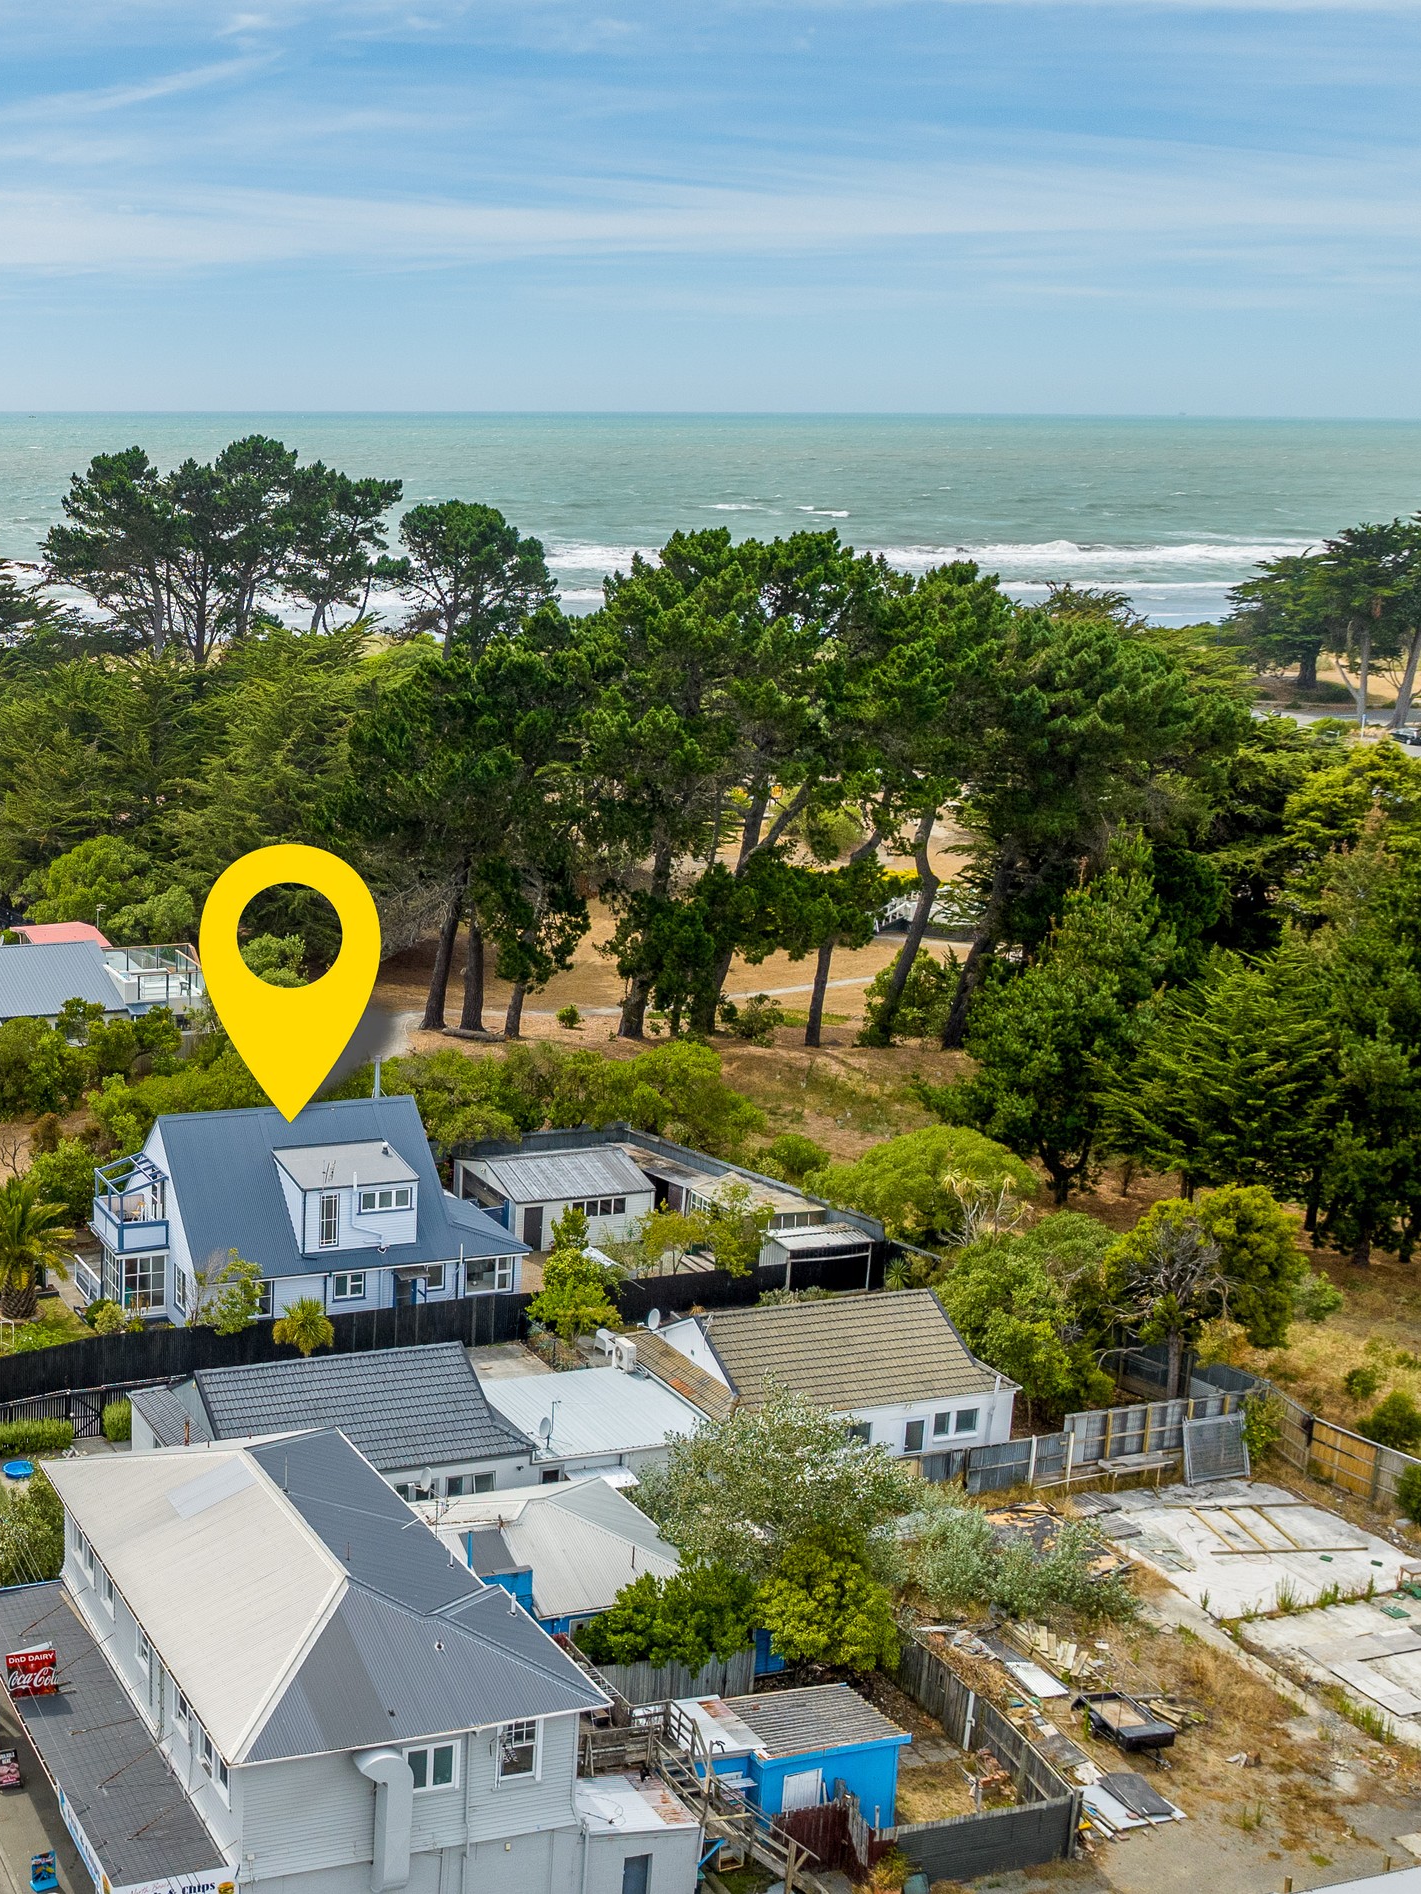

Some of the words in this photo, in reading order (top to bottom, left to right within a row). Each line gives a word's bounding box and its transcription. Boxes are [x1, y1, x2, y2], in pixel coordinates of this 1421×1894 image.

[8, 1656, 26, 1664] DnD
[28, 1652, 54, 1662] DAIRY
[181, 1881, 216, 1894] Chips
